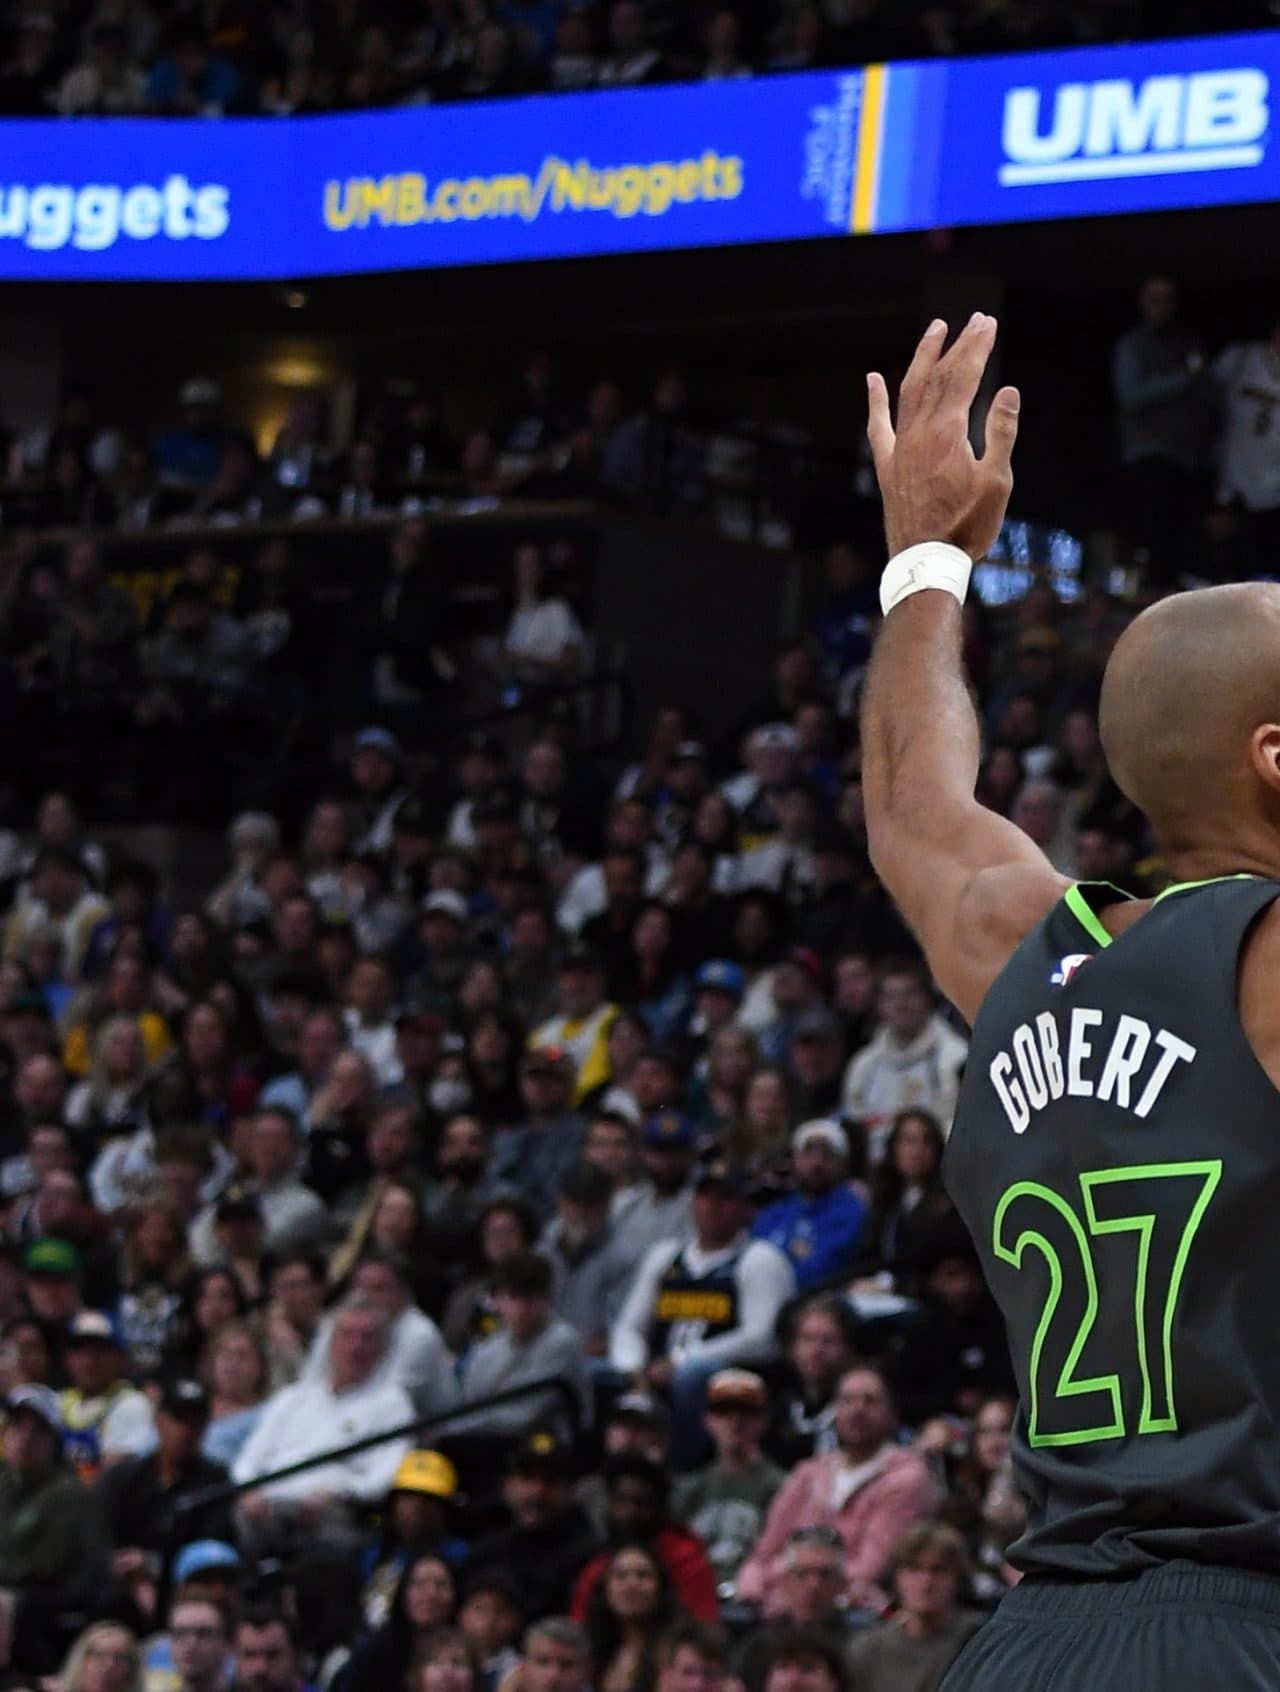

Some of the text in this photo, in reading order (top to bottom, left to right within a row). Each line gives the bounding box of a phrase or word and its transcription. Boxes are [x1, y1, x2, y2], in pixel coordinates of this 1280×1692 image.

[1002, 67, 1269, 164] UMB
[0, 173, 231, 251] uggets
[324, 149, 743, 231] UMB.com/Nuggets
[989, 1008, 1197, 1134] GOBERT
[993, 1159, 1223, 1448] 27
